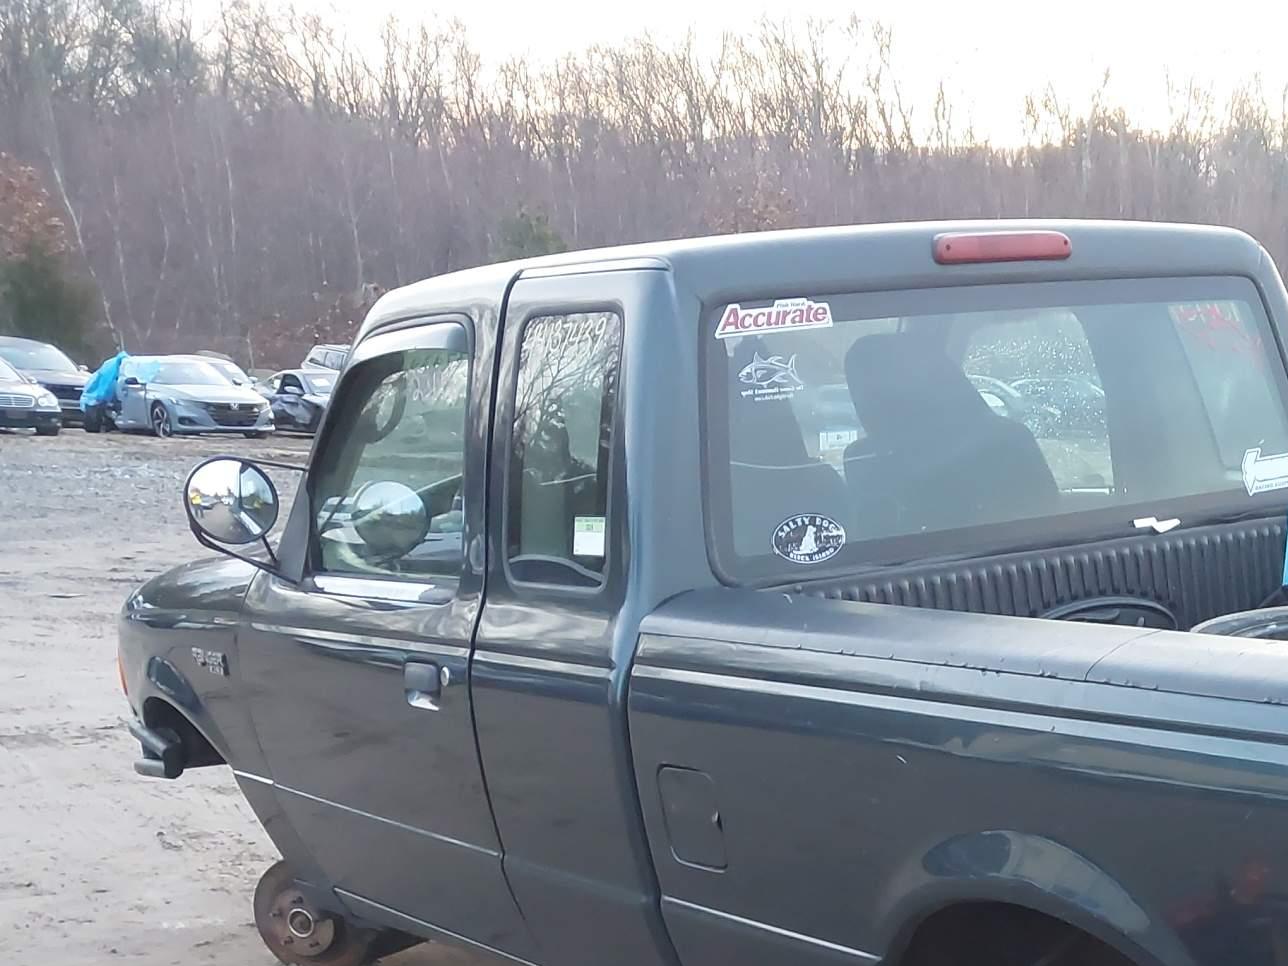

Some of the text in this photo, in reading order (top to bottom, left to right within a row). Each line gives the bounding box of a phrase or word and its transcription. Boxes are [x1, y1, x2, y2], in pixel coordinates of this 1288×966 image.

[721, 304, 828, 332] Accurate
[778, 516, 837, 538] SALTY DOG
